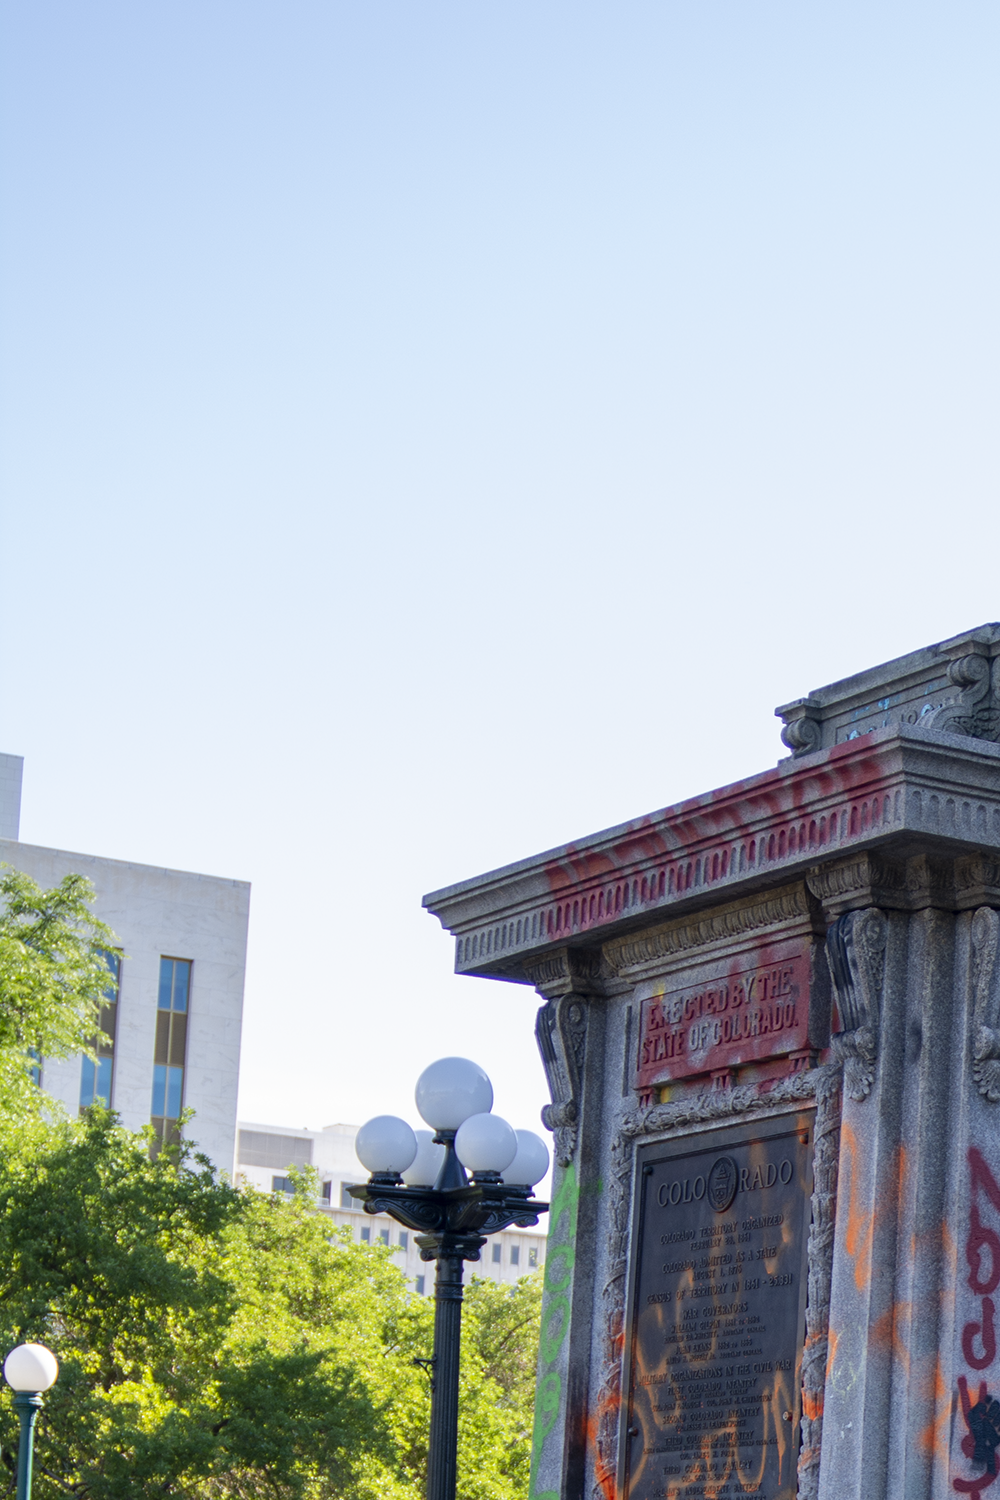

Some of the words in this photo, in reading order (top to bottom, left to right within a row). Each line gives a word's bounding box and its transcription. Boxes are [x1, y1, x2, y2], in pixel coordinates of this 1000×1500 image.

[649, 987, 727, 1031] ERECTED
[731, 977, 757, 1008] BY
[759, 964, 794, 1001] THE
[641, 1028, 685, 1065] STATE
[689, 1020, 710, 1052] OF
[659, 1228, 695, 1244] COLORADO
[699, 1221, 737, 1238] TERRITORY
[741, 1213, 784, 1231] ORGANIZED
[661, 1258, 696, 1274] COLORADO
[699, 1252, 732, 1268] ADMITTED
[735, 1250, 745, 1262] AS
[755, 1245, 776, 1259] STATE
[646, 1290, 671, 1304] CENSUS
[676, 1288, 685, 1300] OF
[689, 1282, 727, 1298] TERRITORY
[730, 1280, 739, 1292] IN
[681, 1307, 699, 1320] WAR
[702, 1300, 748, 1317] GOVERNORS
[669, 1366, 722, 1382] ORGANIZATIONS
[724, 1365, 734, 1377] IN
[735, 1363, 749, 1375] THE
[753, 1361, 772, 1373] CIVIL
[774, 1359, 791, 1371] WAR
[687, 1381, 721, 1393] COLORADO
[725, 1377, 757, 1389] INFANTRY
[690, 1410, 723, 1422] COLORADO
[727, 1407, 760, 1418] INFANTRY
[722, 1430, 754, 1441] INFANTRY
